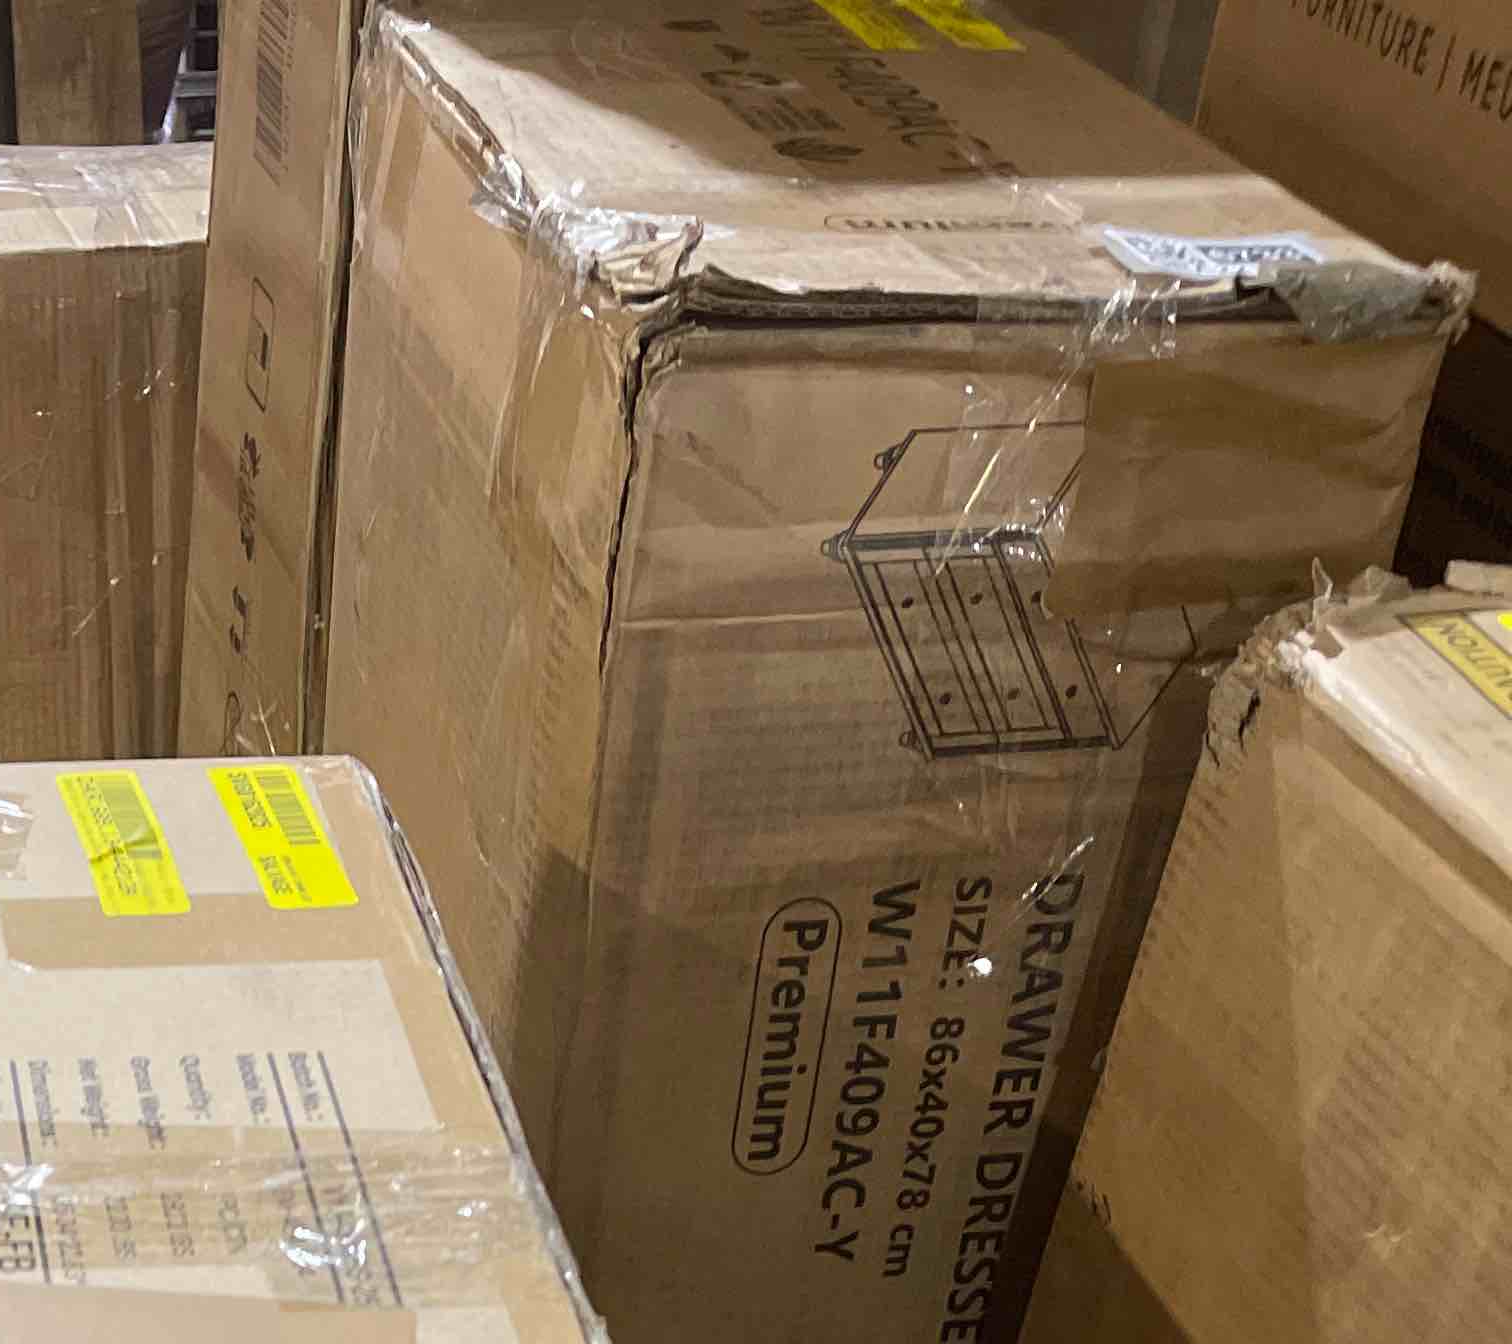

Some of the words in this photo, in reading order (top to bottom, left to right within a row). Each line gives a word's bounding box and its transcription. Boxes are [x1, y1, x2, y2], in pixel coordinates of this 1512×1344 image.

[1291, 0, 1435, 77] RNITURE
[938, 876, 993, 991] SIZE:
[981, 872, 1086, 1137] DRAWER
[747, 918, 830, 1162] Premium
[813, 879, 921, 1262] W11F409AC-Y
[895, 1016, 967, 1211] 86x40x78
[882, 1223, 915, 1278] cm
